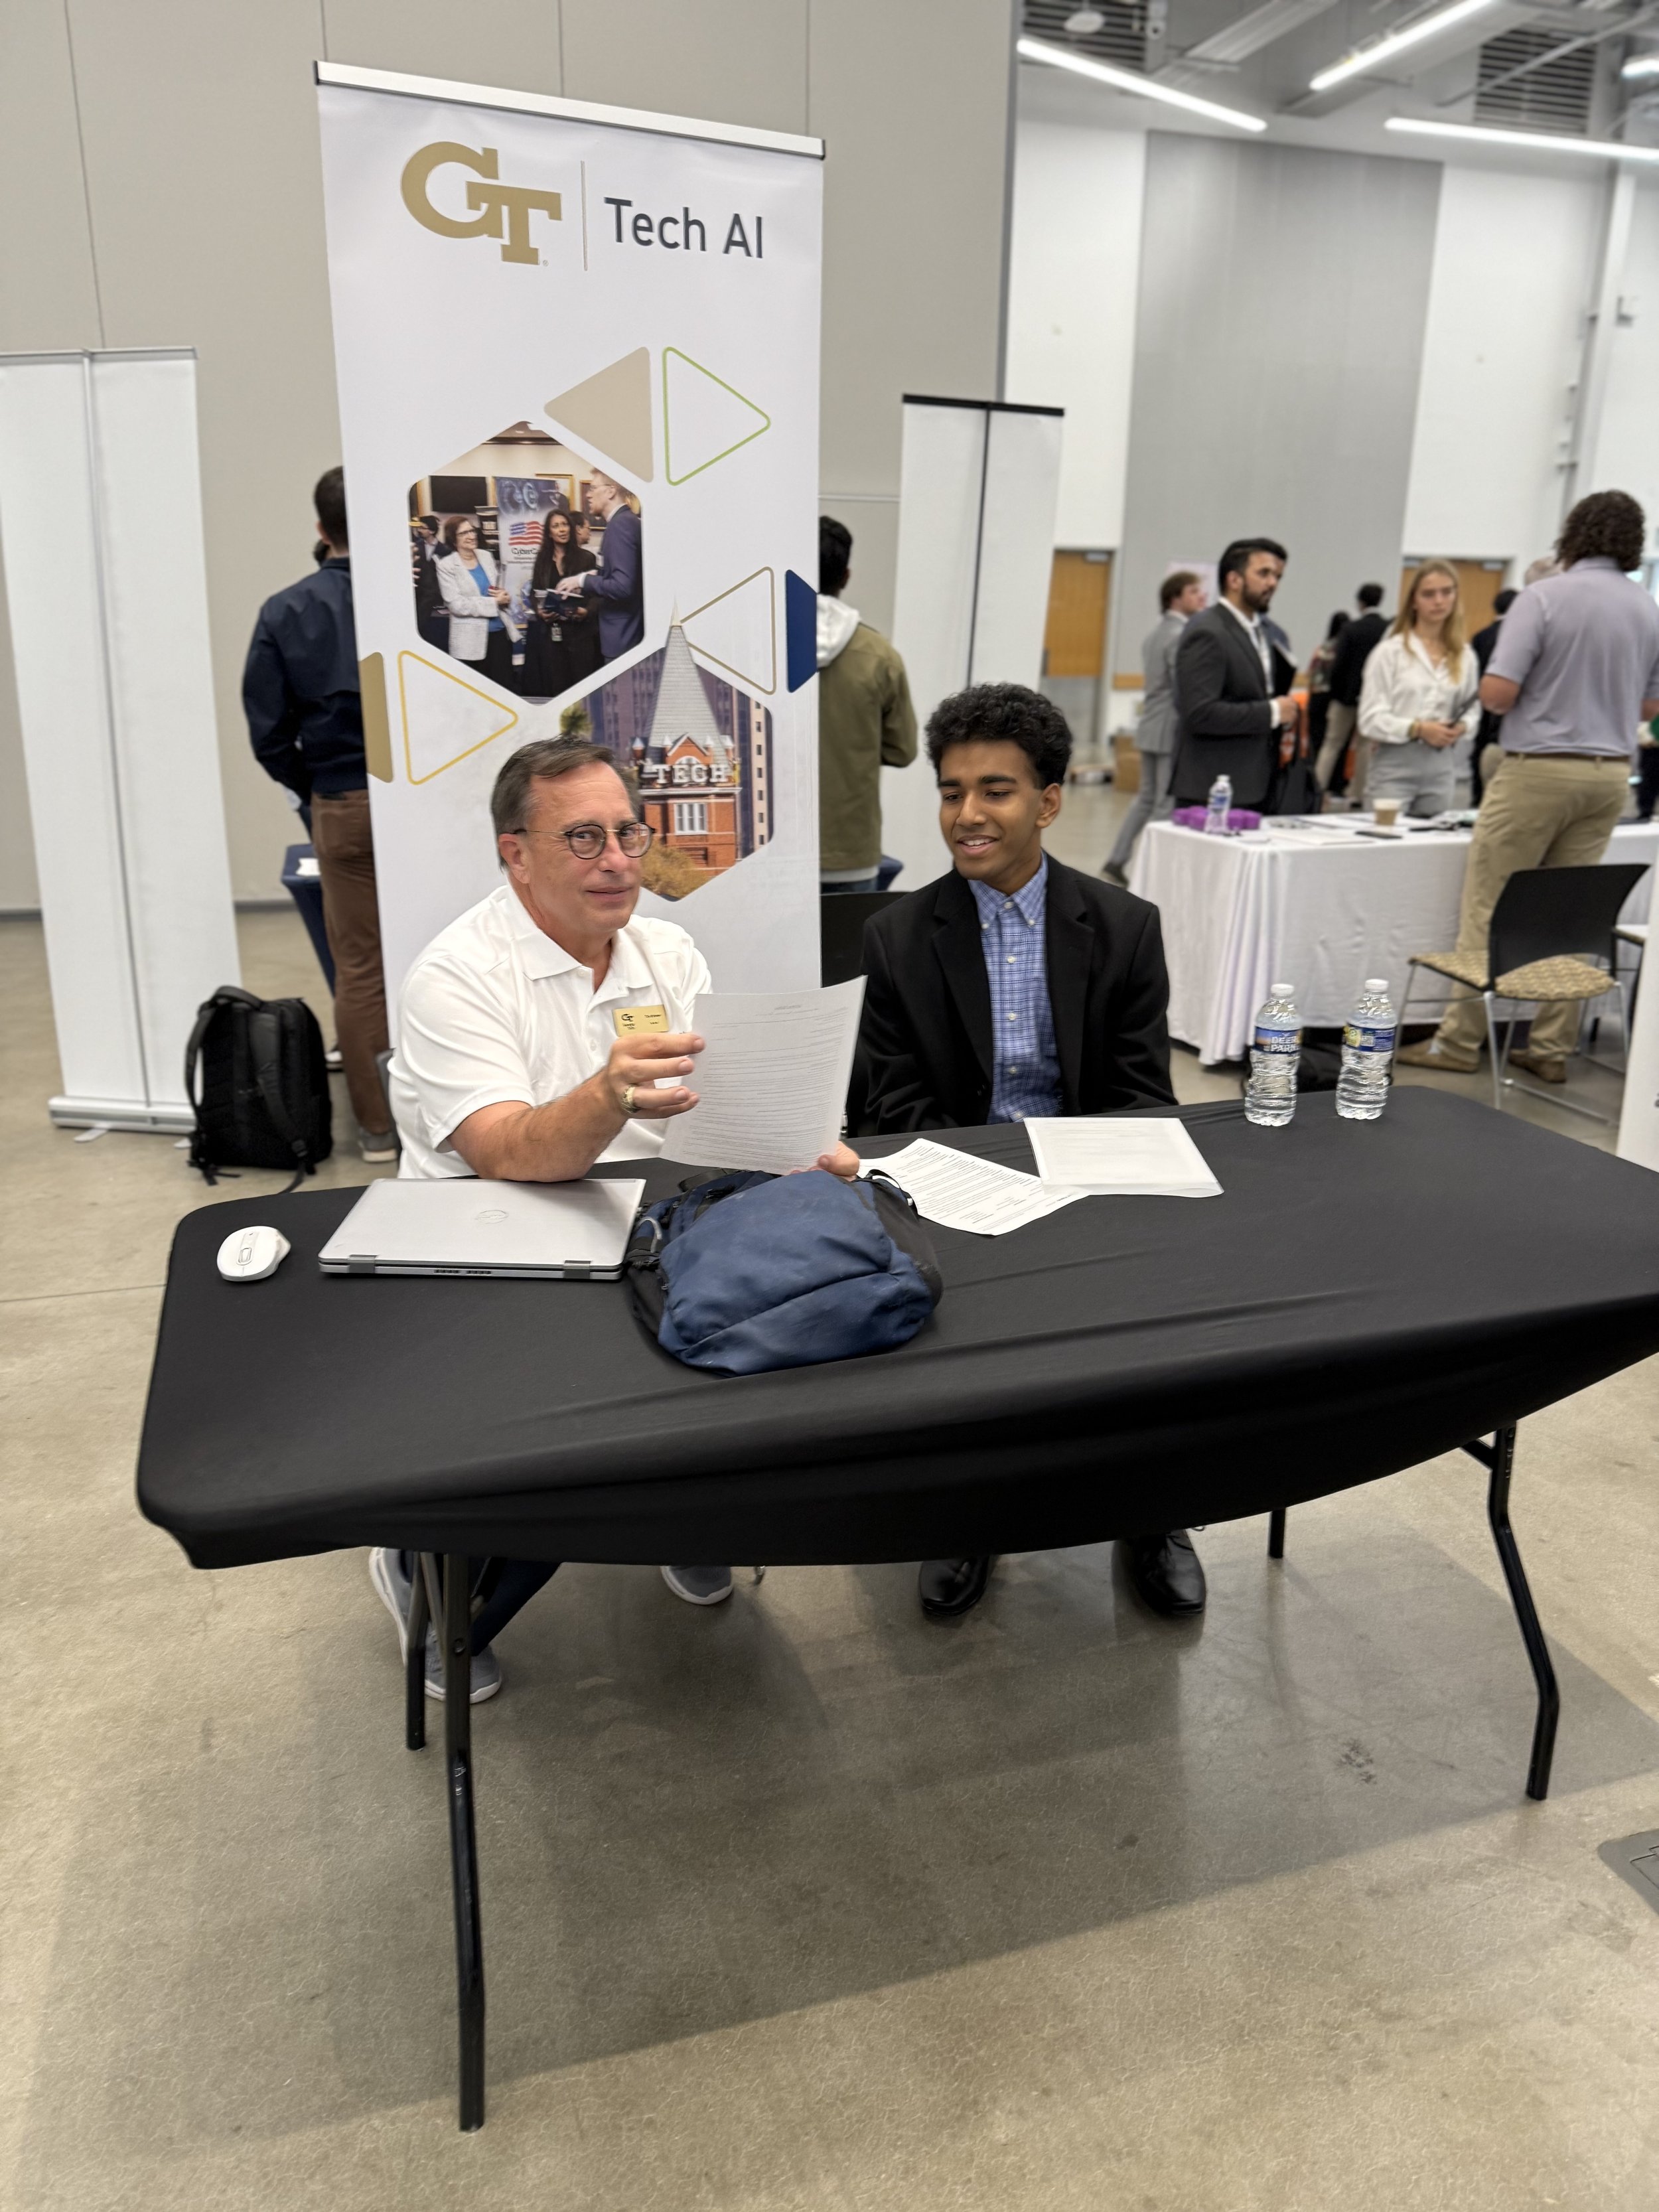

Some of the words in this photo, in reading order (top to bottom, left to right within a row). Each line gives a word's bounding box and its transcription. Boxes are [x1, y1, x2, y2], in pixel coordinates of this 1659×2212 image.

[400, 141, 563, 265] GT
[604, 196, 707, 252] Tech
[723, 213, 764, 259] AI
[652, 764, 729, 784] TECH
